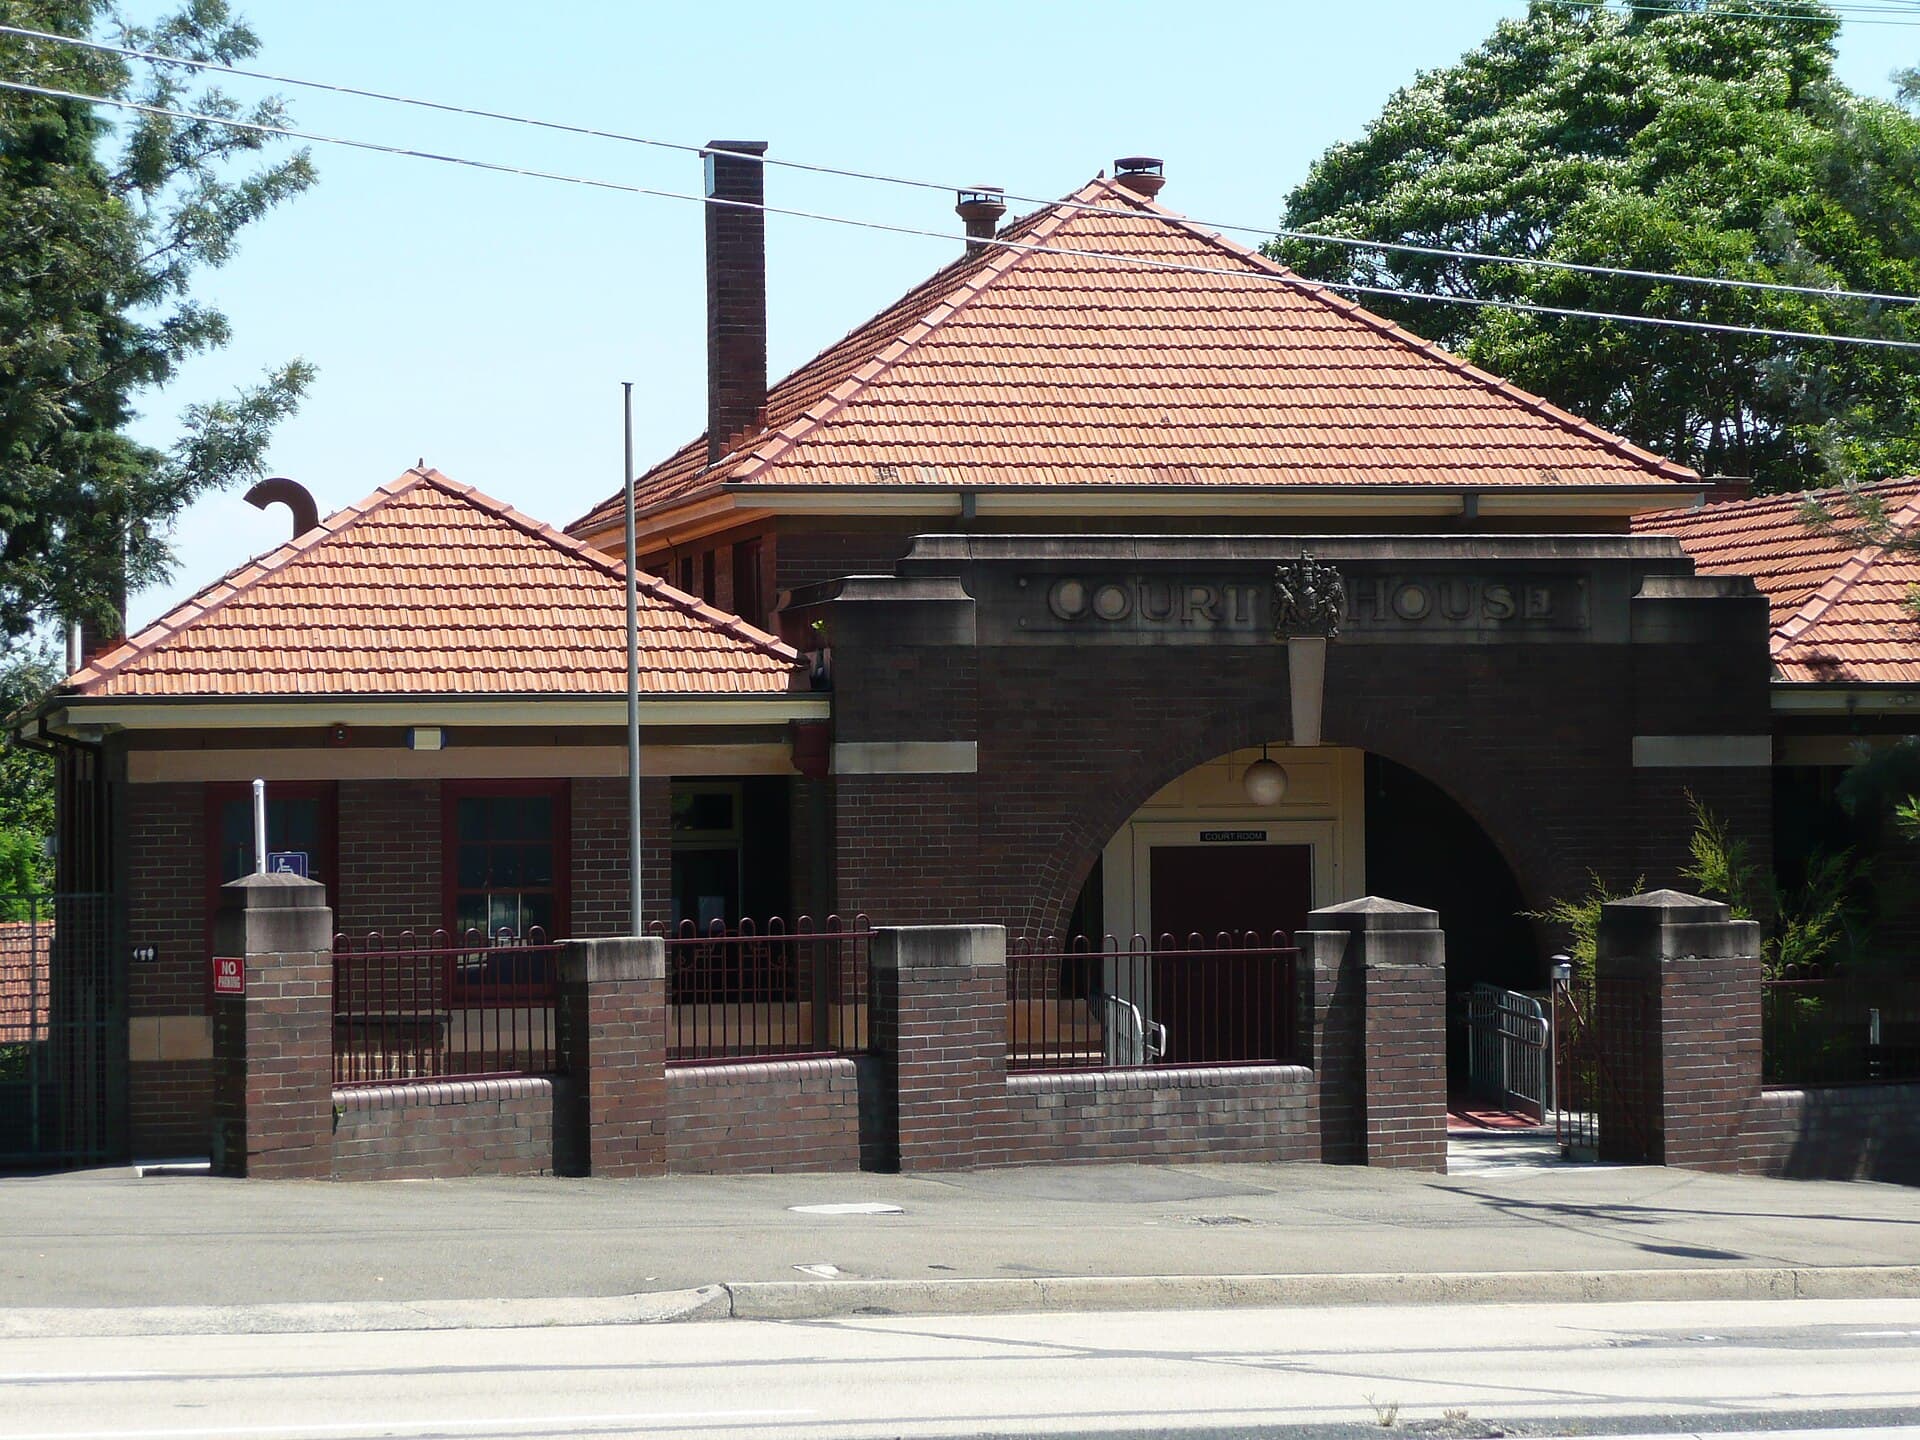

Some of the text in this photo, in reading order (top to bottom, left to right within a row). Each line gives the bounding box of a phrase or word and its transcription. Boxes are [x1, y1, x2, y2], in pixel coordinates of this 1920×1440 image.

[1048, 576, 1554, 622] COURT HOUSE
[1205, 832, 1263, 841] COURT ROOM
[222, 961, 237, 975] NO
